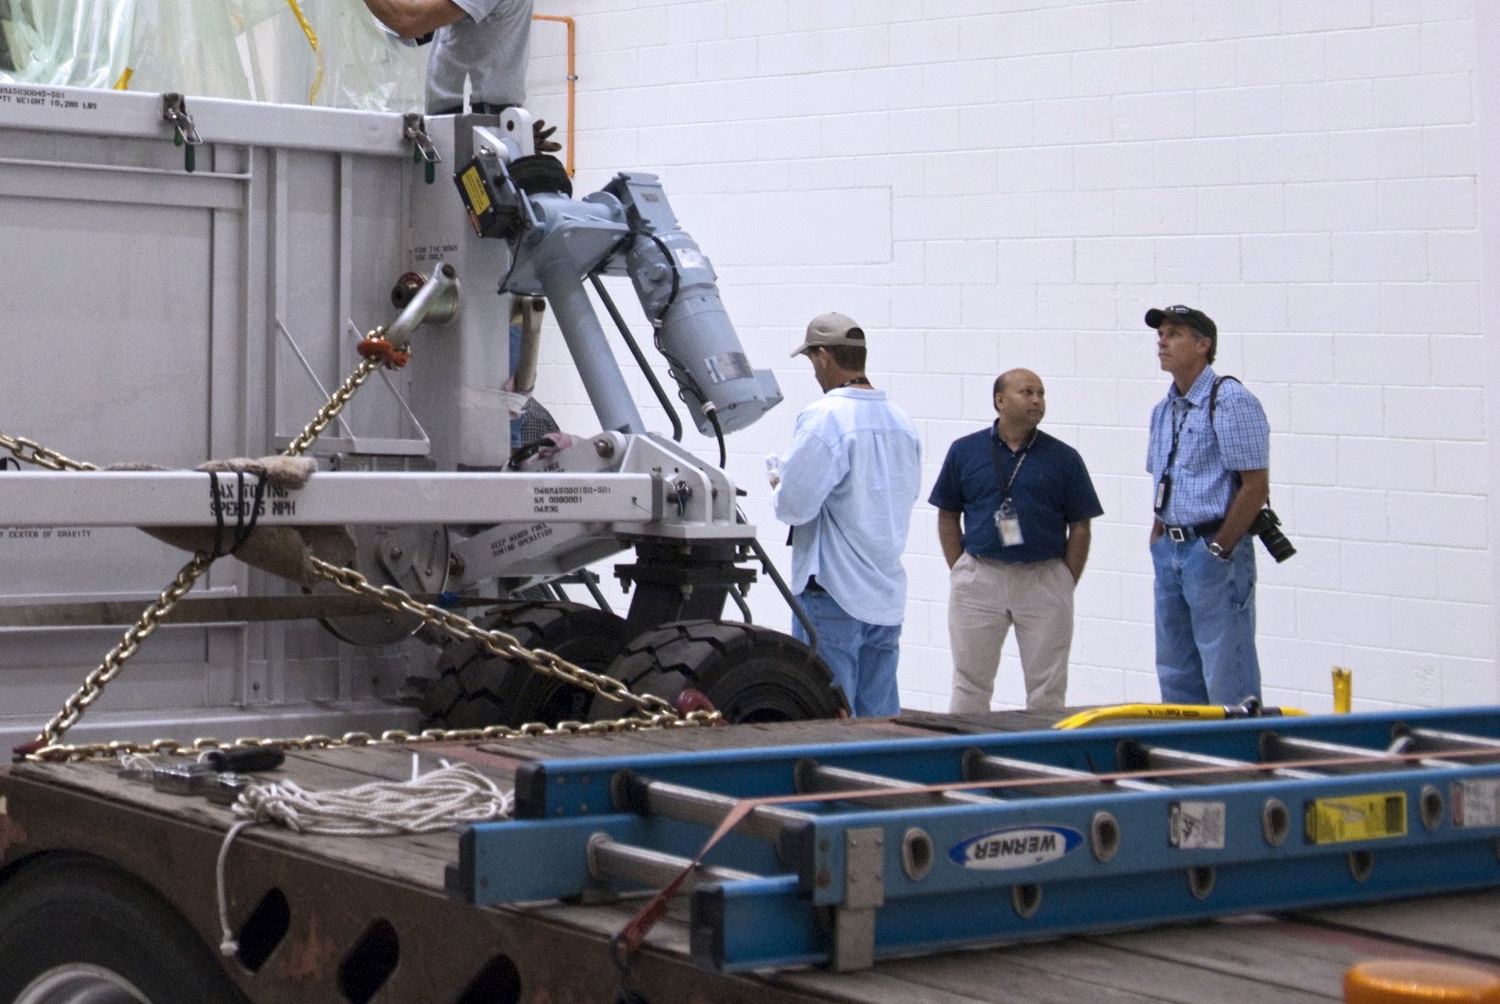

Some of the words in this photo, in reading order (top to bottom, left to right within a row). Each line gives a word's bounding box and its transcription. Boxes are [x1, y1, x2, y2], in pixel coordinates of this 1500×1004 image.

[16, 97, 45, 105] WEIGHT
[8, 530, 39, 539] CENTER
[43, 530, 53, 539] OF
[57, 530, 92, 539] GRAVITY
[975, 835, 1056, 860] WERNER
